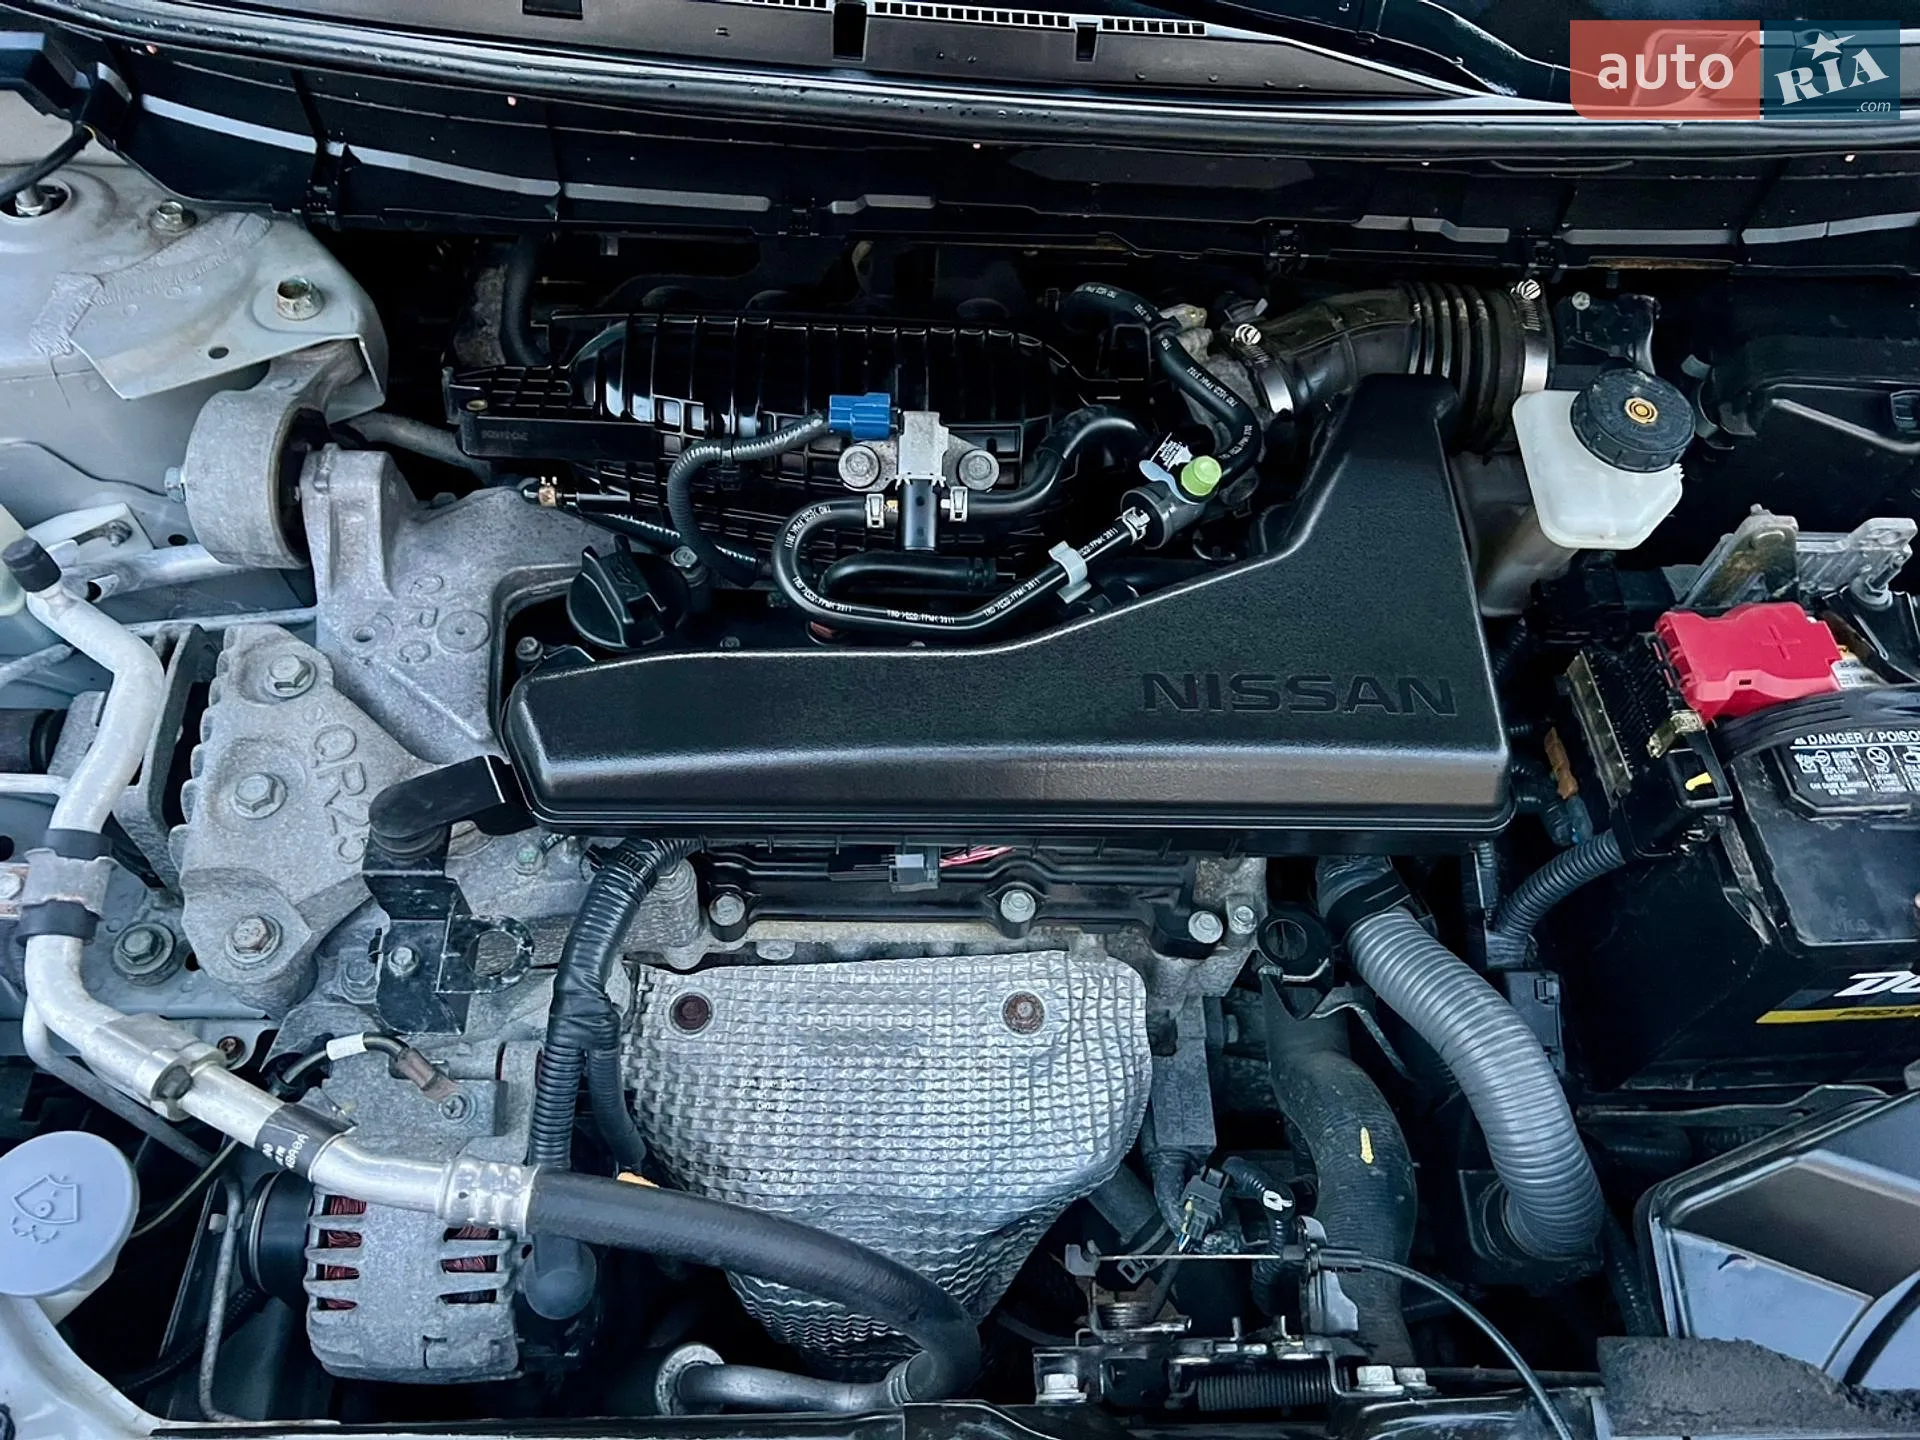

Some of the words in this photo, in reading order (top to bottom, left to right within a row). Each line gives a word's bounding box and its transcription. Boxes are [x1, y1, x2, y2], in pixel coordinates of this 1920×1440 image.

[1142, 672, 1458, 716] NISSAN
[1807, 731, 1866, 745] DANGER
[1877, 730, 1920, 743] POISO
